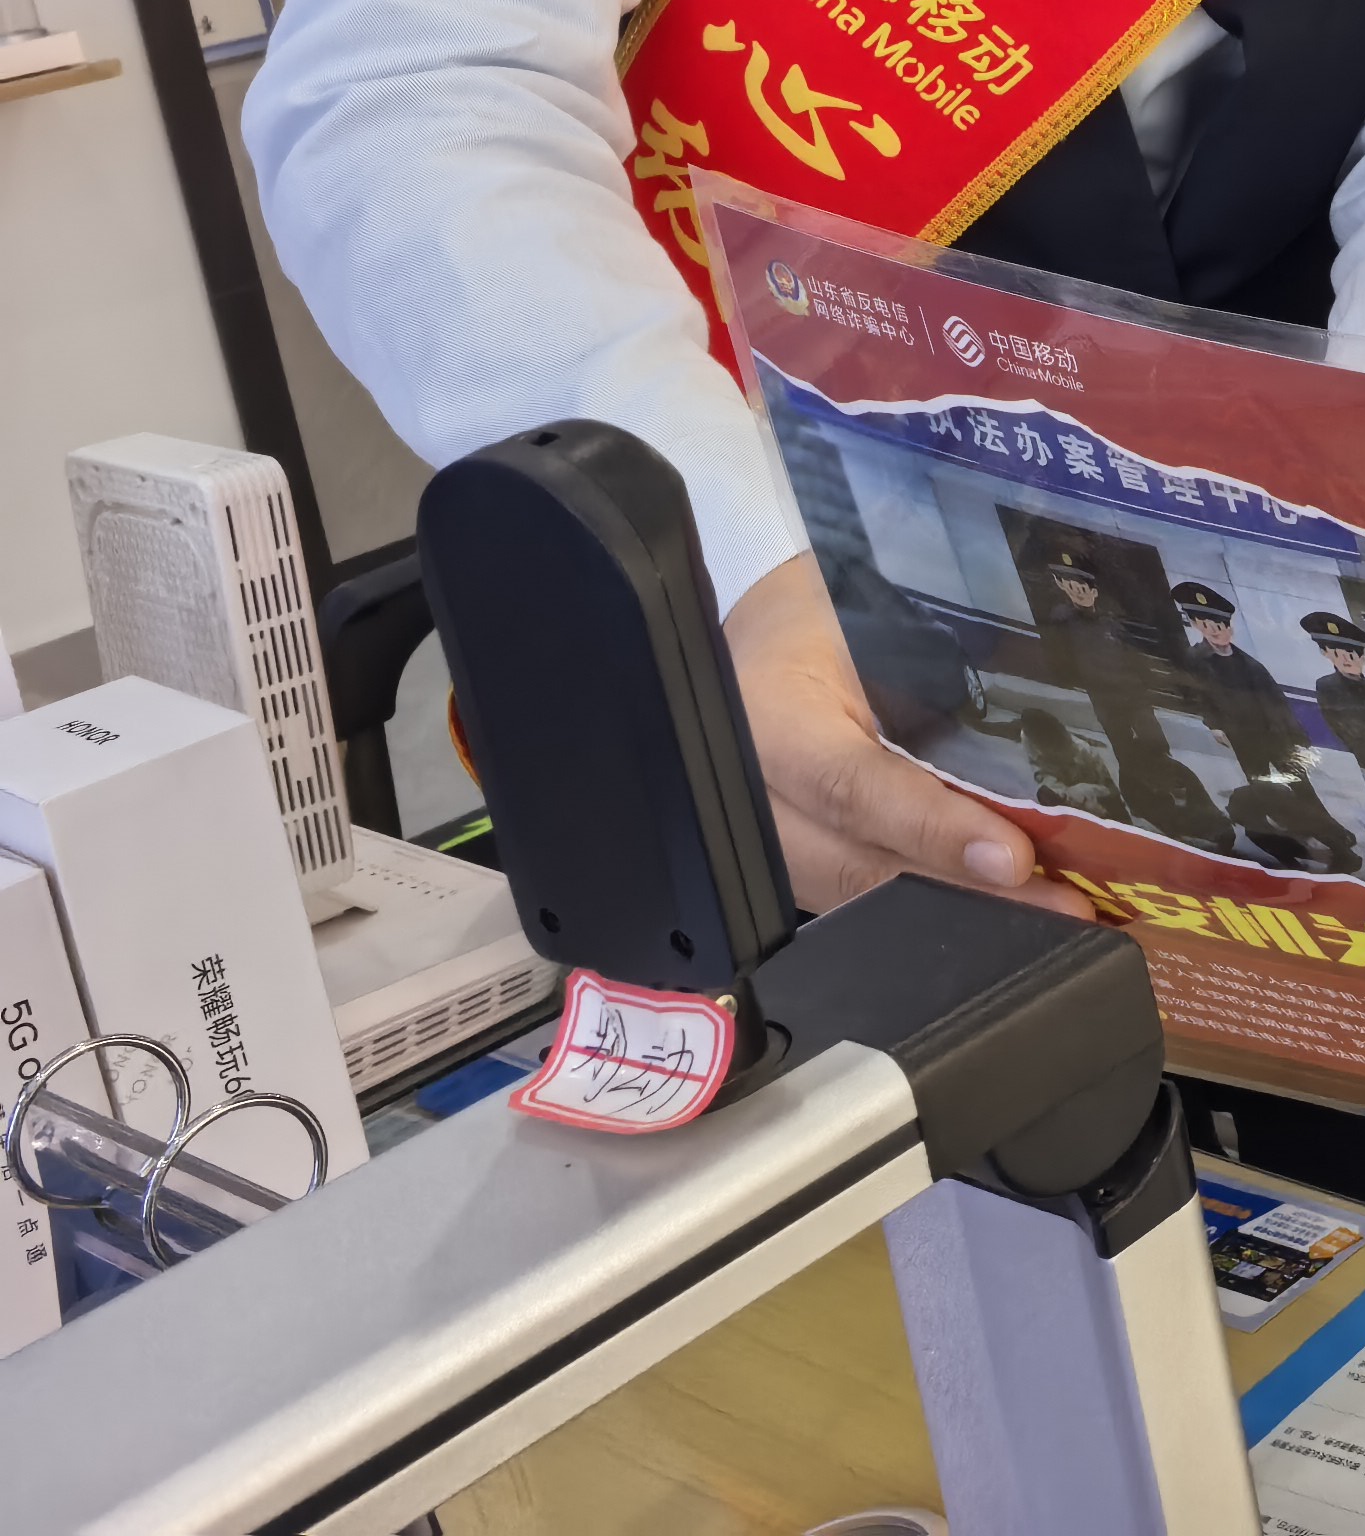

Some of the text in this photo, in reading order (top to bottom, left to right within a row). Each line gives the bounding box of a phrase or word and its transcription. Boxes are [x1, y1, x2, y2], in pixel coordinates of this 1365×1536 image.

[862, 24, 981, 131] Mobile
[806, 276, 910, 324] 山东省反电信
[813, 298, 915, 346] 网络诈骗中心
[988, 330, 1079, 373] 中国移动
[996, 357, 1085, 393] China Mobile
[56, 720, 120, 746] HONOR
[0, 999, 38, 1052] 5G
